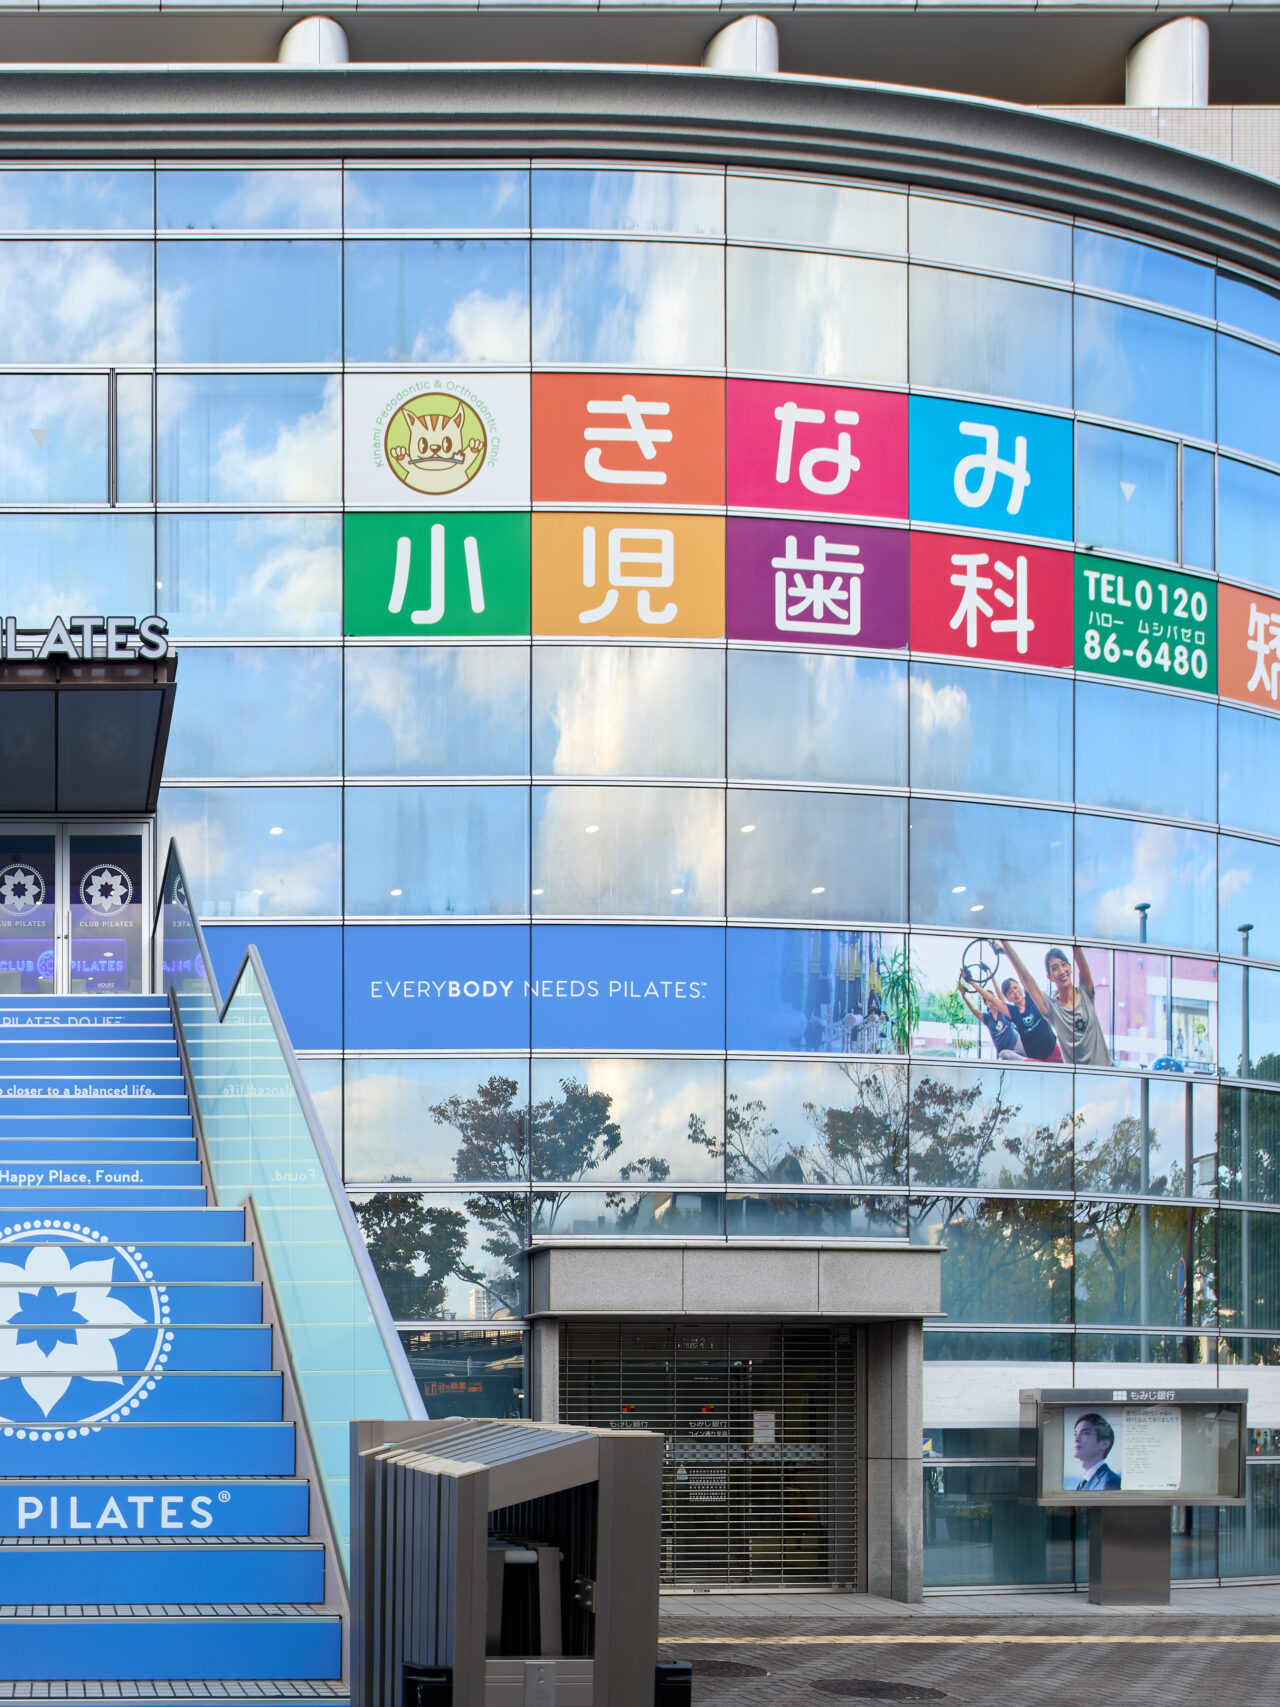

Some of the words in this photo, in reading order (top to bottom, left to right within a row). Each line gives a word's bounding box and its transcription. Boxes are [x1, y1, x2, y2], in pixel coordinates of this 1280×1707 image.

[433, 379, 443, 388] &
[375, 379, 430, 426] Pedodontic
[446, 380, 498, 434] Orthodontic
[373, 427, 384, 468] Kinami
[487, 436, 500, 468] Clinic
[583, 393, 1031, 515] きなみ
[387, 523, 1035, 654] 小児歯科
[1088, 610, 1125, 628] ハロー
[1137, 619, 1206, 645] ムシバゼロ
[1083, 628, 1208, 679] 86-6480
[71, 960, 124, 972] PILATES
[371, 980, 514, 998] EVERYBODY
[523, 980, 600, 998] NEEDS
[6, 1084, 43, 1096] closer
[47, 1085, 60, 1096] to
[63, 1087, 70, 1096] a
[74, 1084, 128, 1096] balanced
[132, 1084, 156, 1097] life.
[49, 1169, 92, 1185] Place,
[95, 1169, 144, 1183] Found.
[1130, 1390, 1176, 1401] もみじ銀行
